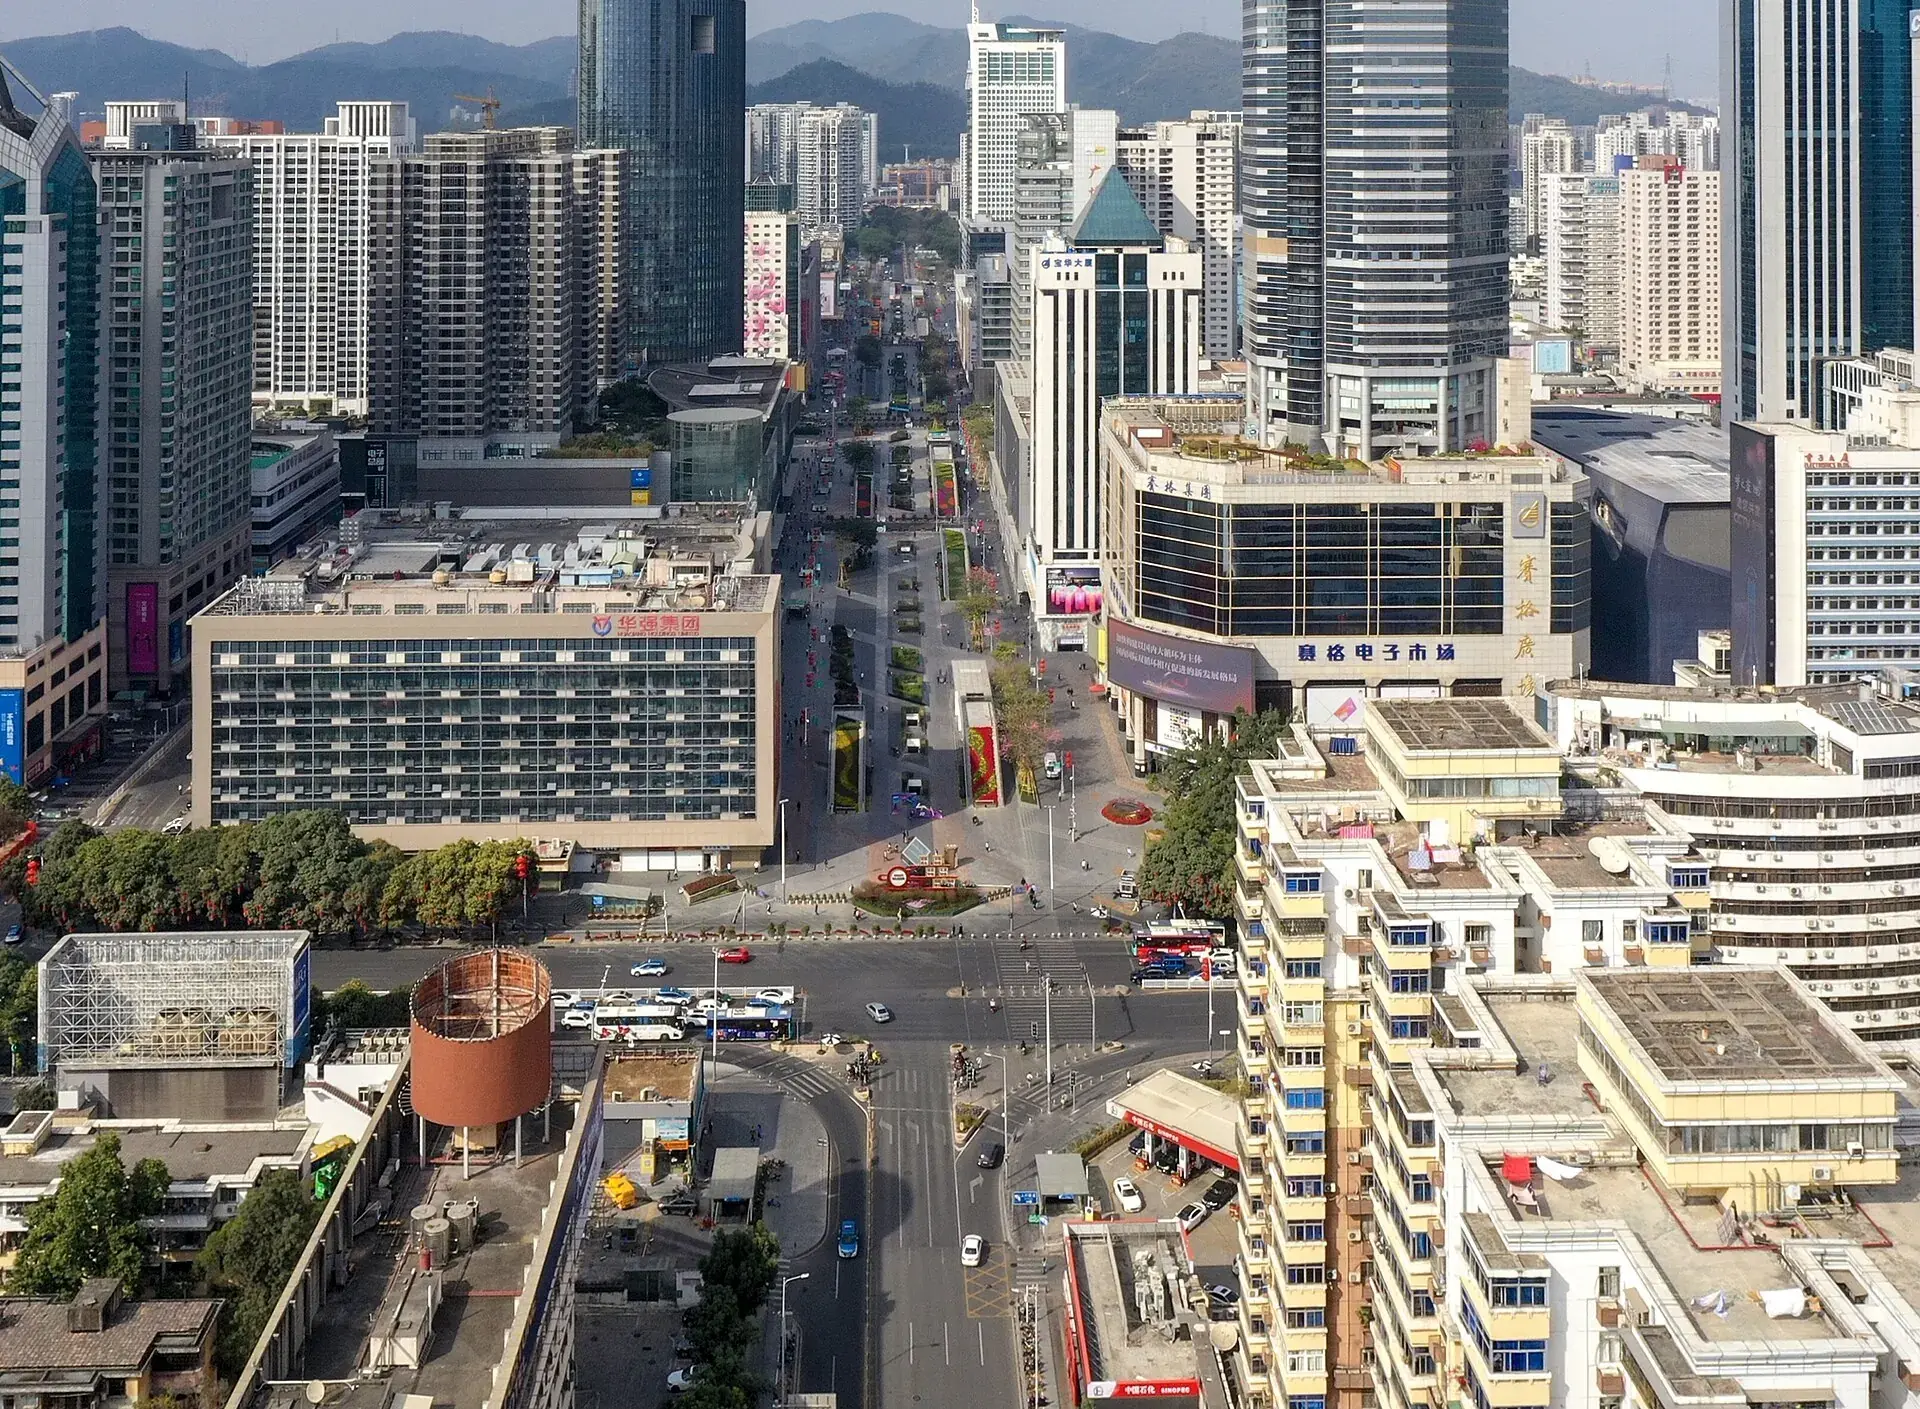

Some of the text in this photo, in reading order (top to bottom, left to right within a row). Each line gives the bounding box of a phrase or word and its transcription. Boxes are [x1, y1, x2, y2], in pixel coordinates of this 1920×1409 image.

[617, 615, 700, 632] 华强集团
[1298, 643, 1455, 661] 赛格电子市场
[1124, 1385, 1156, 1395] 中国石化
